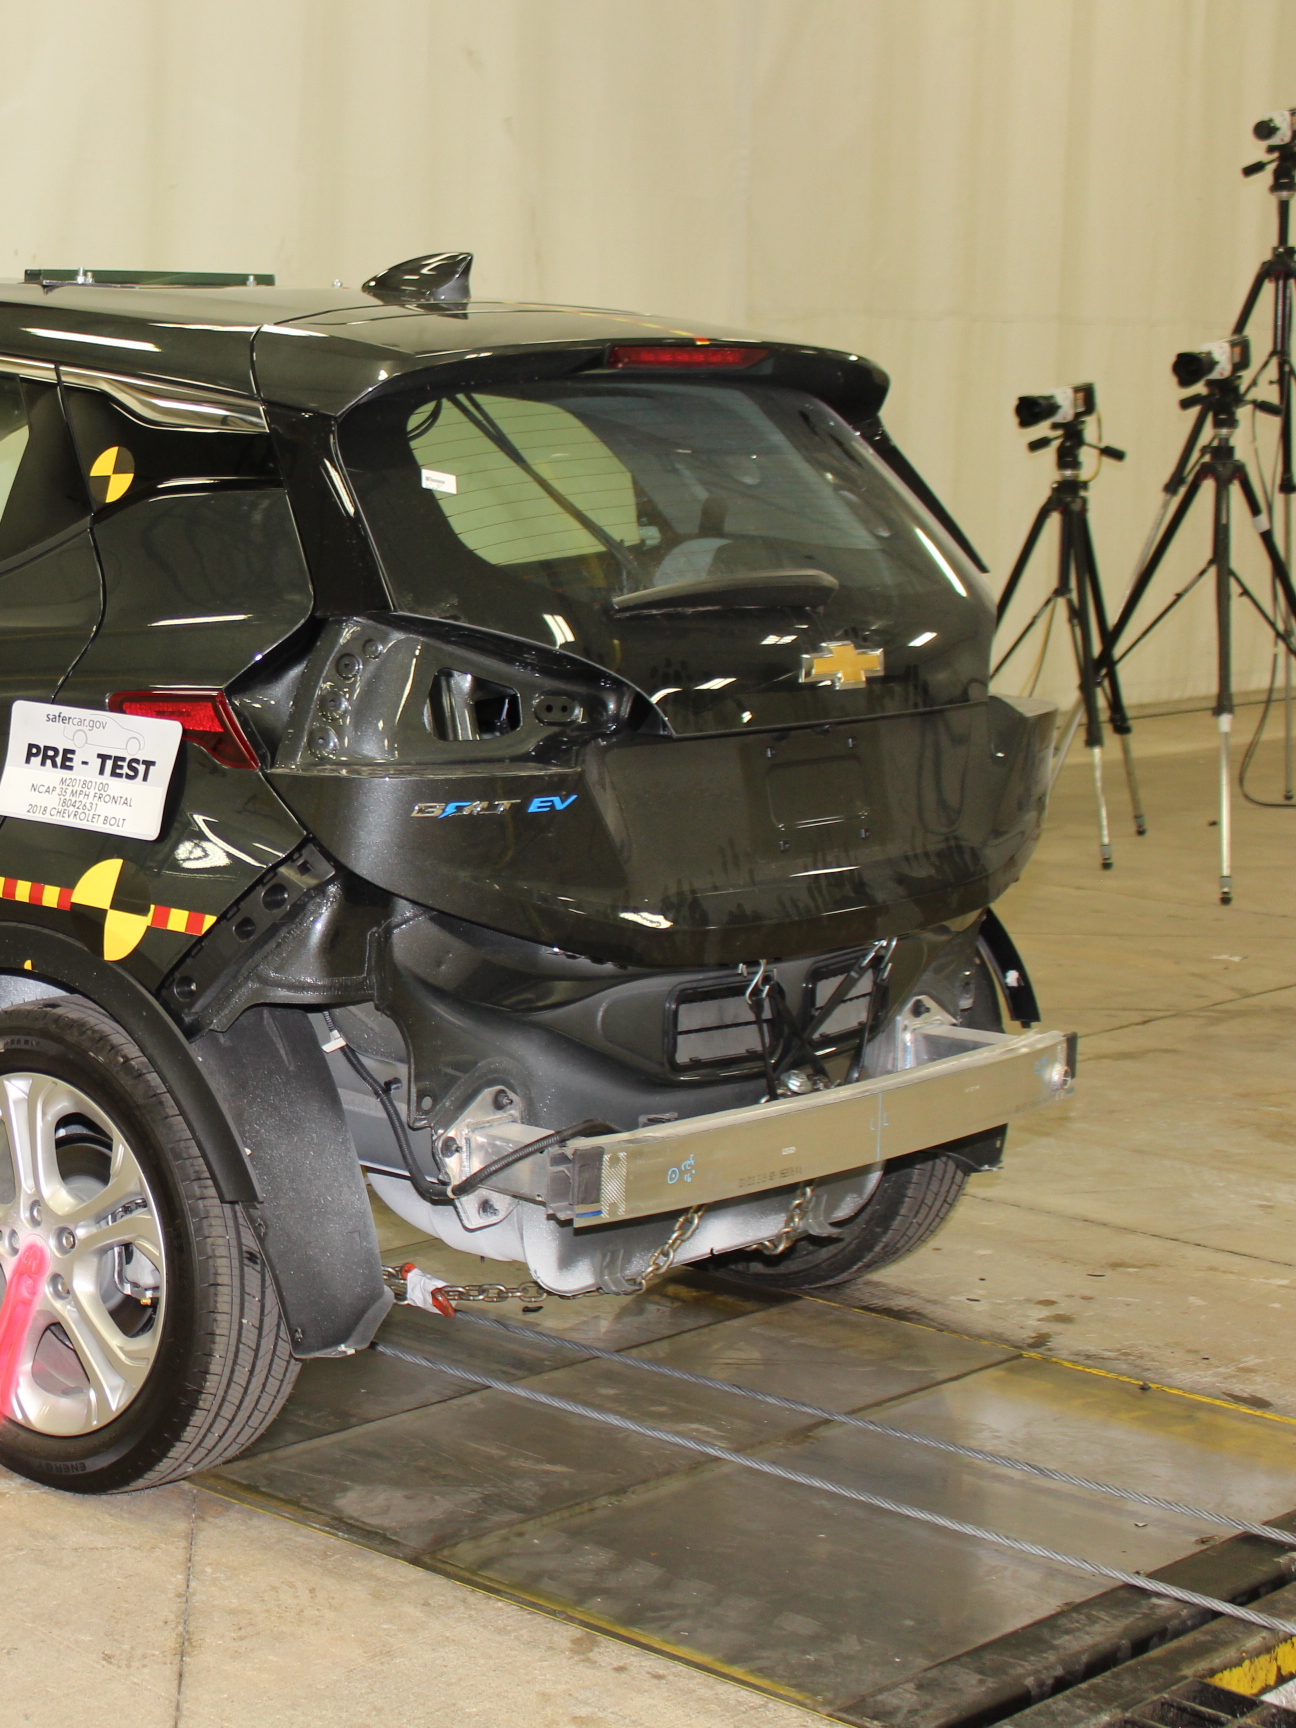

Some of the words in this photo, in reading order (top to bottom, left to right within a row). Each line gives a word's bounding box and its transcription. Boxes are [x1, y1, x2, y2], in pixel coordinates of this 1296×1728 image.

[46, 712, 107, 731] safercar.gov
[25, 743, 76, 771] PRE
[97, 753, 156, 782] TEST
[59, 777, 109, 792] M20180100
[30, 784, 56, 796] NCAP
[58, 788, 68, 797] 35
[70, 789, 91, 800] MPH
[93, 792, 133, 808] FRONTAL
[58, 798, 98, 812] 18042631
[527, 795, 578, 813] EV
[27, 803, 48, 815] 2018
[49, 807, 101, 824] CHEVROLET
[103, 816, 126, 828] BOLT
